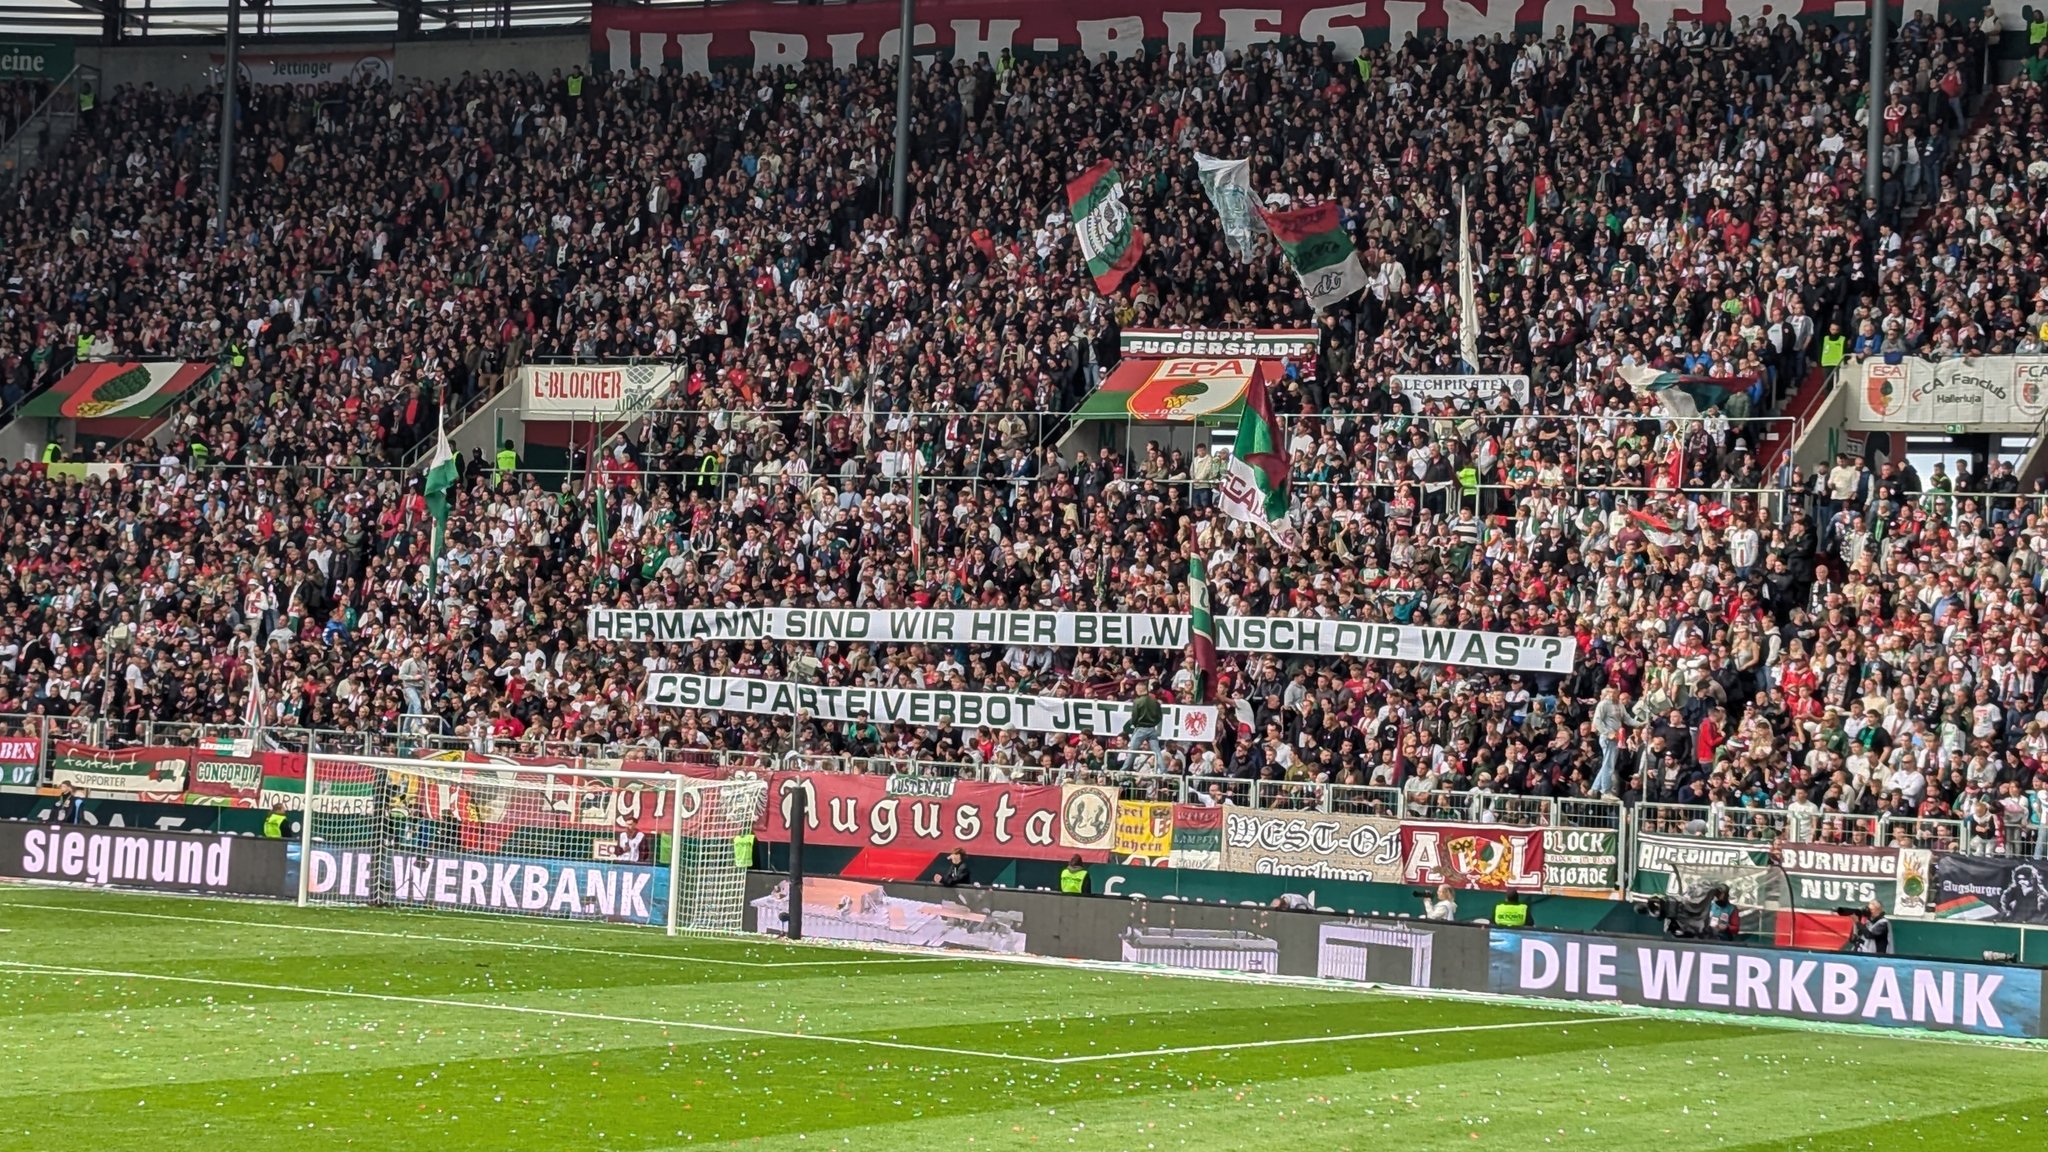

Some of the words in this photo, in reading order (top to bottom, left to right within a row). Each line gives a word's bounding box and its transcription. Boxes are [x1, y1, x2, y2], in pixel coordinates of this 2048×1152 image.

[272, 61, 333, 78] Jettinger
[1183, 331, 1254, 341] GRUPPE
[1130, 341, 1305, 356] FUGGERSTADT
[1166, 361, 1243, 376] FCA
[1873, 365, 1901, 376] FCA
[1404, 379, 1509, 391] LECHPIRATEN
[1912, 378, 1944, 402] FCA
[1952, 373, 2006, 400] Fanclub
[785, 611, 871, 638] SIND
[890, 611, 955, 640] WIR
[971, 612, 1057, 643] HIER
[1074, 614, 1132, 645] BEI
[1140, 616, 1319, 651] „WNSCH
[1335, 623, 1400, 656] DIR
[654, 675, 1035, 727] CSU-PARTEIVERBOT
[74, 773, 126, 787] SUPPORTER
[196, 762, 263, 783] CONCORDIA
[780, 778, 1057, 845] Augusta
[1543, 830, 1605, 853] BLOCK
[23, 825, 232, 886] siegmund
[1782, 850, 1896, 875] BURNING
[308, 850, 371, 897] DIE
[393, 856, 650, 918] WERKBANK
[1801, 879, 1877, 902] NUTS
[1943, 879, 2002, 896] Augsburger
[1519, 938, 1618, 997] DIE
[1637, 948, 2005, 1029] WERKBANK
